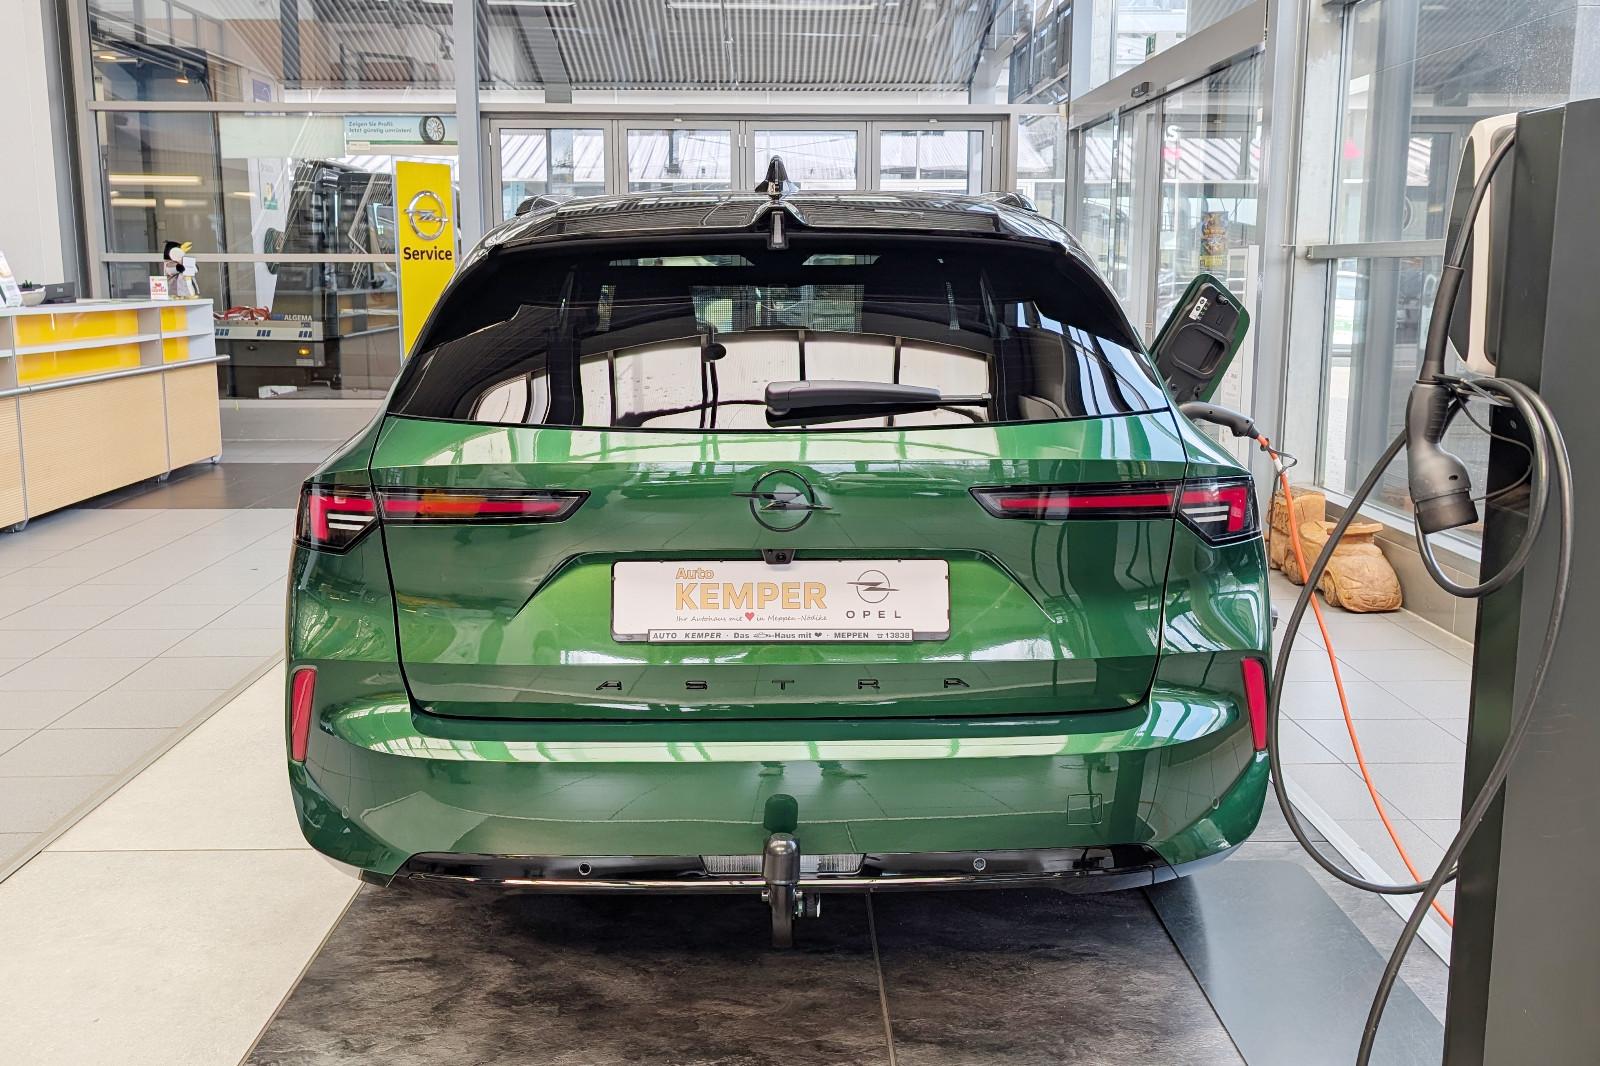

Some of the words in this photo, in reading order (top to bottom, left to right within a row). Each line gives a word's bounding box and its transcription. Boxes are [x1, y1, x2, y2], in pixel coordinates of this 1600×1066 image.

[403, 245, 453, 261] Service
[675, 567, 715, 580] Auto
[675, 582, 828, 610] KEMPER
[846, 610, 902, 619] OPEL
[652, 632, 678, 640] AUTO
[684, 632, 722, 640] KEMPER
[596, 679, 970, 692] ASTRA
